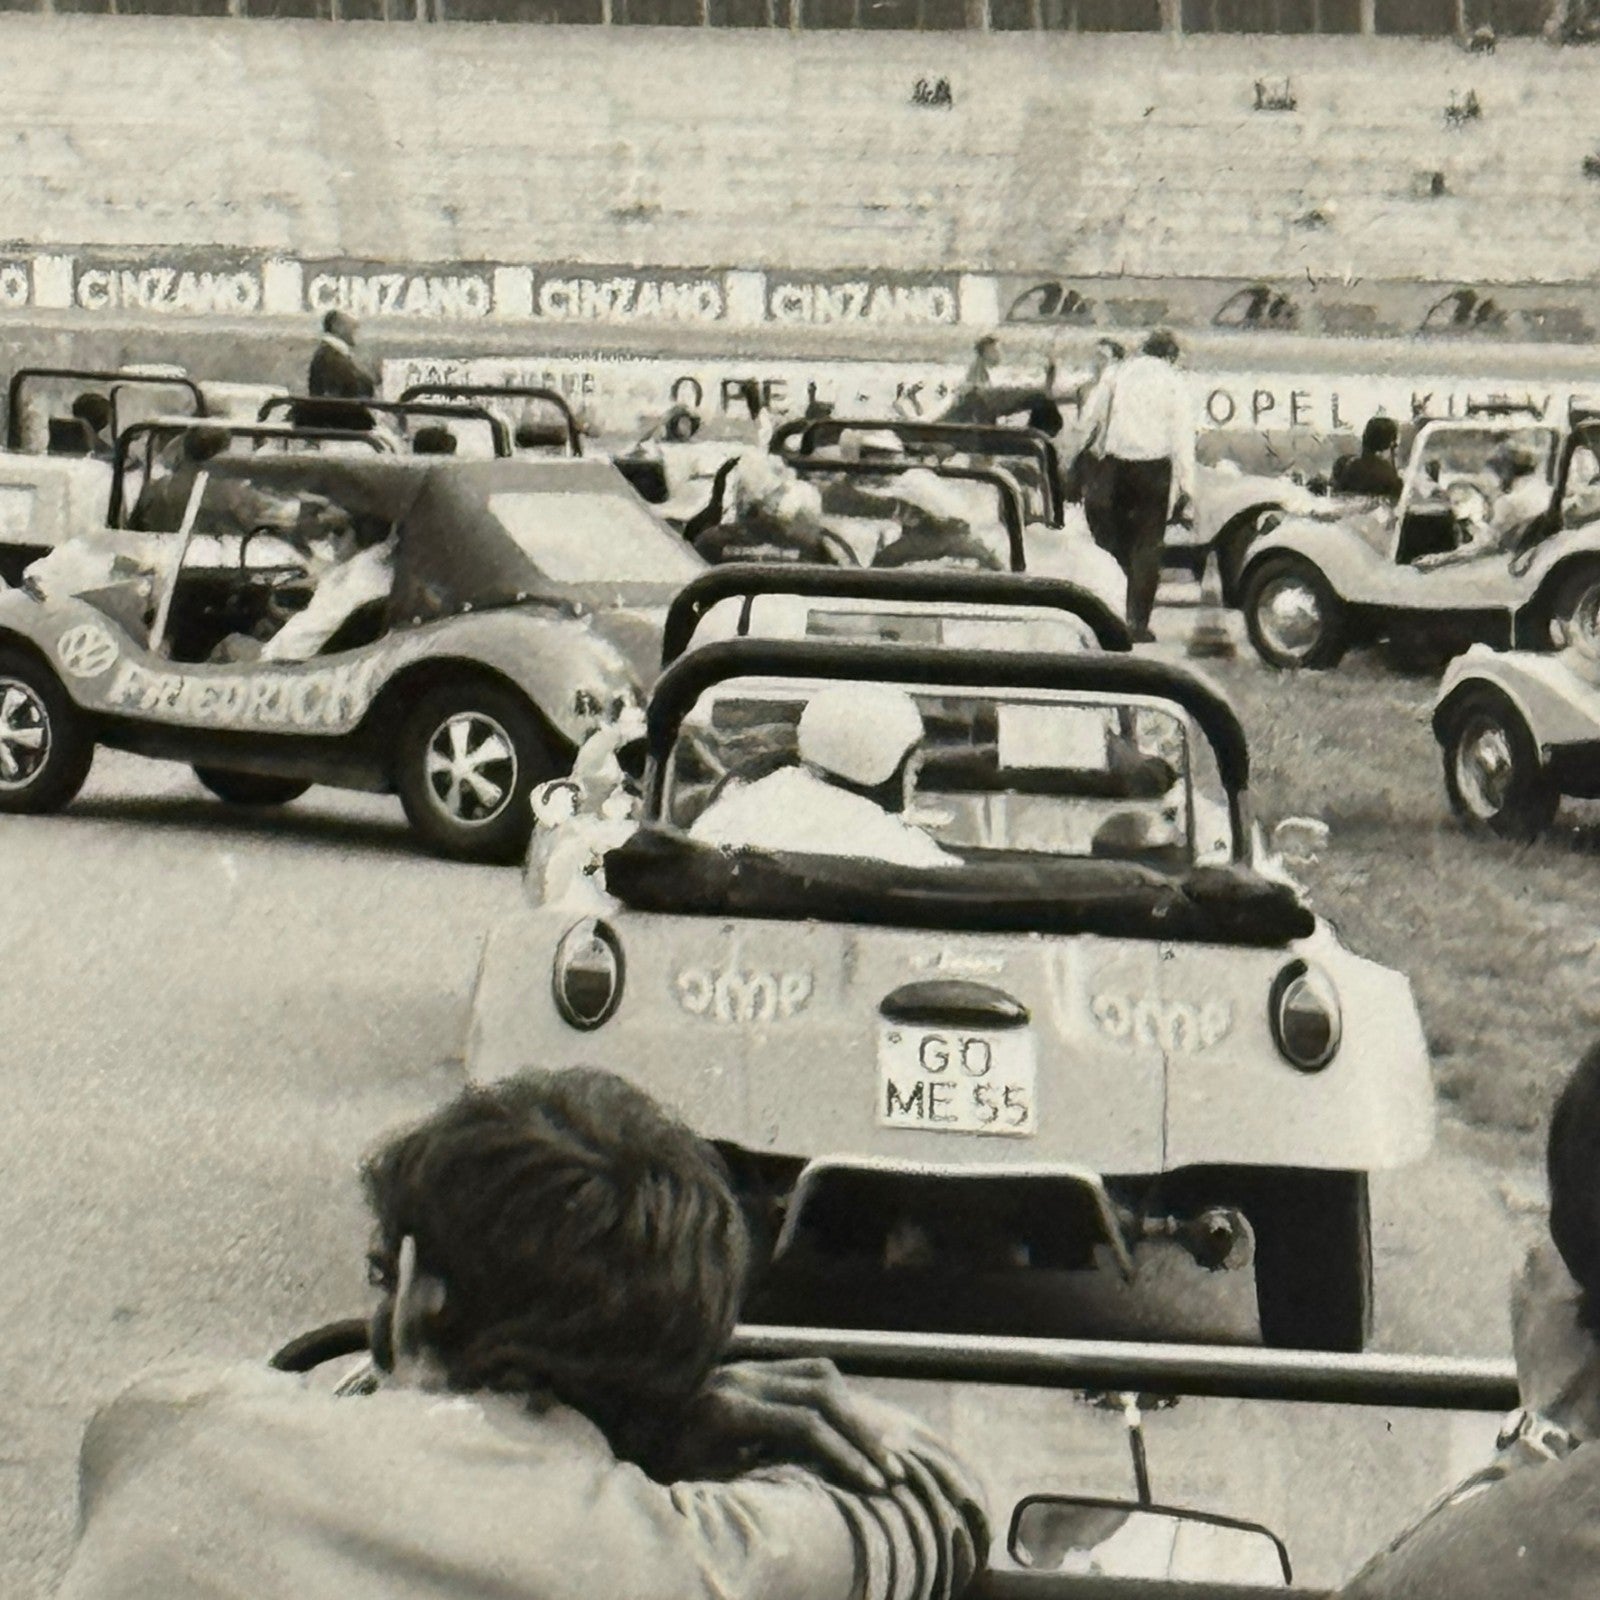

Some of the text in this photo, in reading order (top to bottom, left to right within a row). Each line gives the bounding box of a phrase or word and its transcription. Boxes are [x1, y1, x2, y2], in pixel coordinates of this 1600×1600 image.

[78, 268, 261, 313] CINZANO
[309, 272, 491, 318] CINZANO
[538, 276, 724, 321] CINZANO
[770, 282, 957, 326] CINZANO
[1206, 388, 1353, 430] OPEL
[886, 1078, 959, 1122] ME
